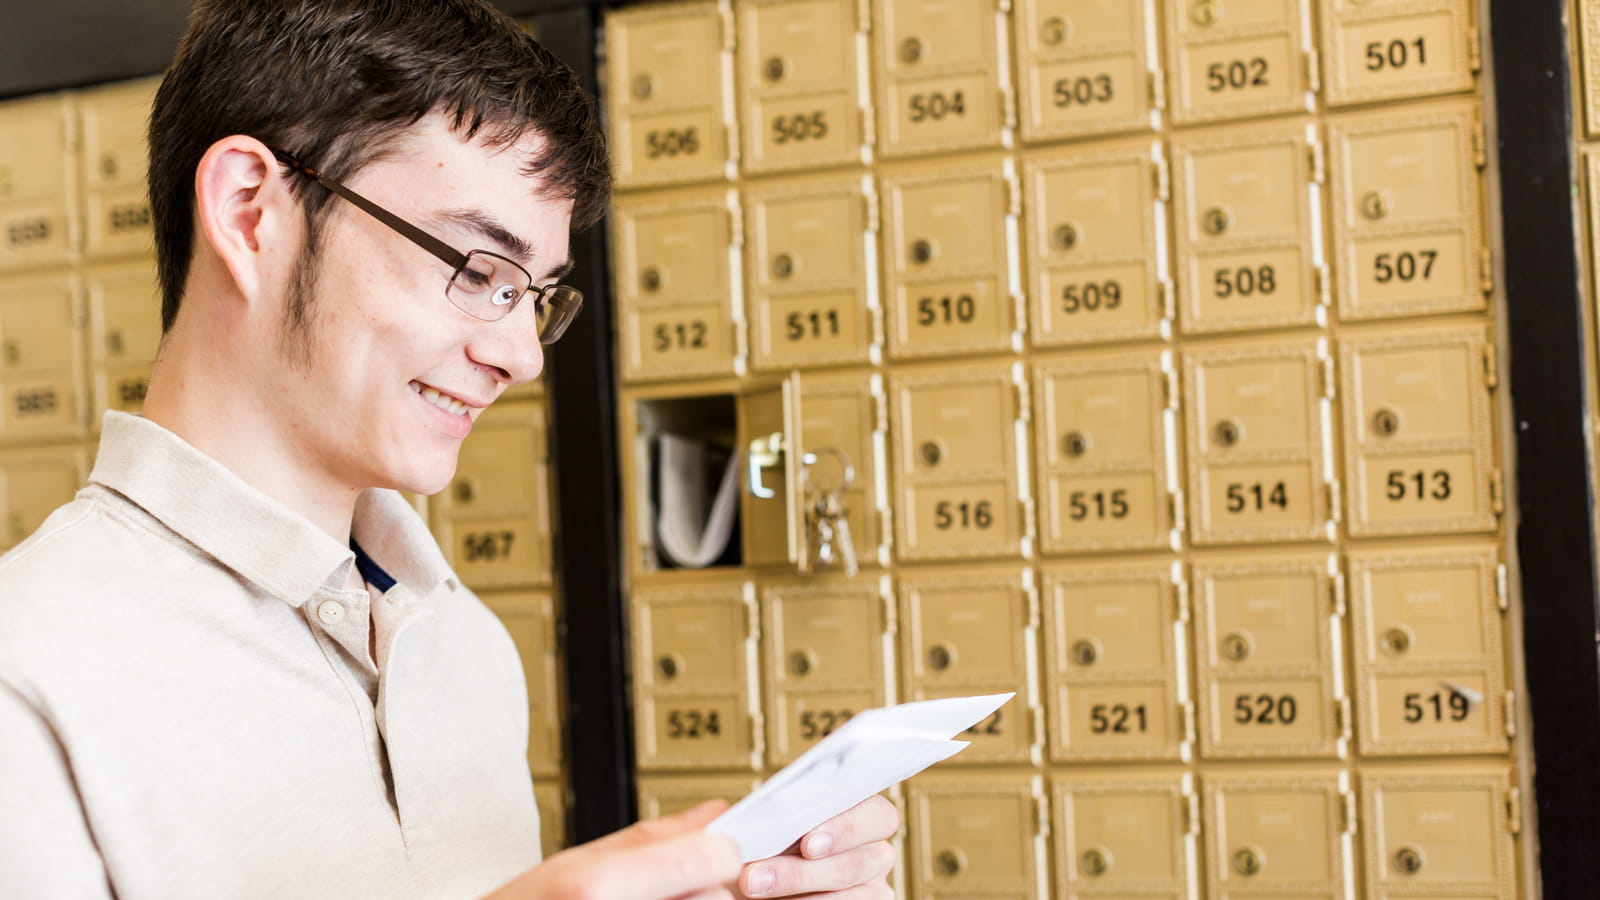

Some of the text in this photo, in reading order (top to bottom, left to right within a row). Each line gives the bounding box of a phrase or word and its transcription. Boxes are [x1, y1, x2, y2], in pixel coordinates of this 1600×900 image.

[1366, 37, 1426, 71] 501
[1208, 58, 1269, 92] 502
[1054, 74, 1114, 108] 503
[910, 91, 966, 123] 504
[773, 111, 829, 144] 505
[646, 128, 700, 159] 506
[1215, 266, 1277, 298] 508
[1375, 251, 1438, 283] 507
[918, 295, 976, 326] 510
[1063, 281, 1122, 314] 509
[654, 321, 707, 352] 512
[787, 310, 839, 341] 511
[1227, 482, 1288, 513] 514
[1387, 470, 1452, 500] 513
[936, 501, 993, 530] 516
[1070, 490, 1130, 520] 515
[464, 532, 515, 561] 567
[1091, 705, 1147, 734] 521
[1236, 695, 1297, 724] 520
[1404, 691, 1469, 723] 519
[668, 710, 722, 740] 524
